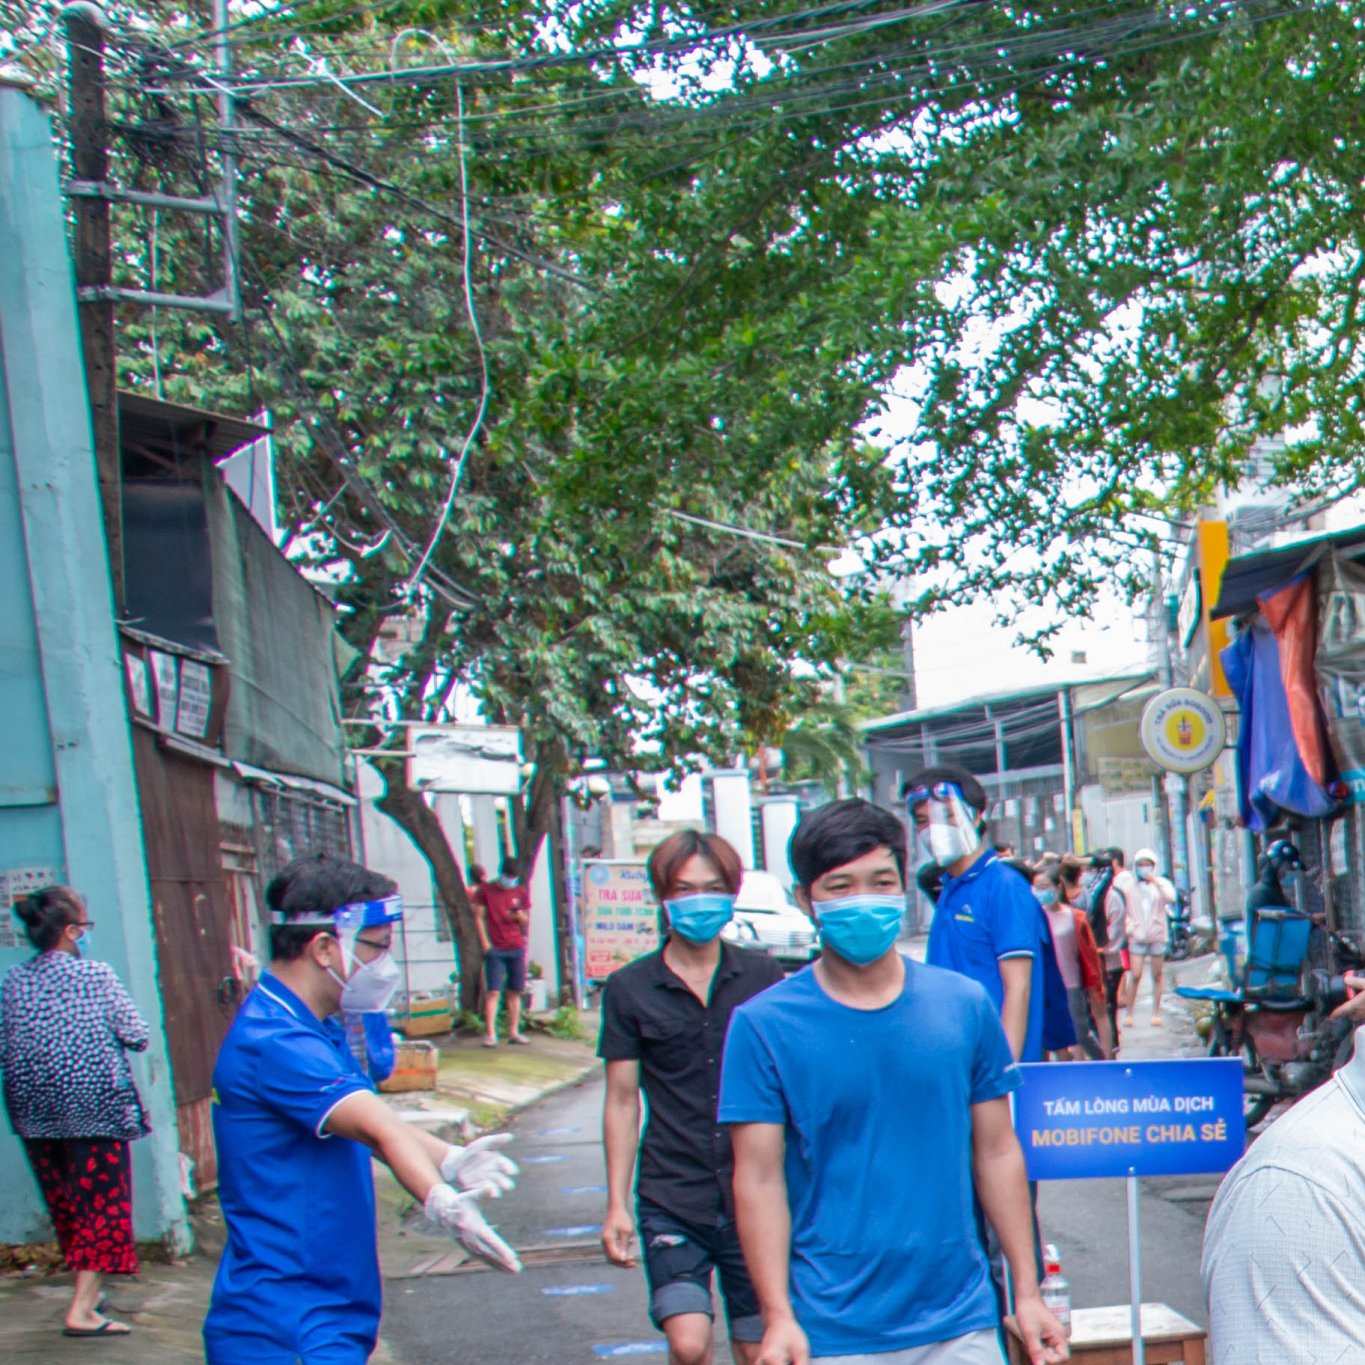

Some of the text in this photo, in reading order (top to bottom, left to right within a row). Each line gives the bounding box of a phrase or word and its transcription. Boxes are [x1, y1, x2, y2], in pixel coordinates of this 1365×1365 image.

[1043, 1094, 1214, 1116] TẤM LÒNG MÙA DỊCH
[1031, 1117, 1228, 1148] MOBIFONE CHIA SẺ
